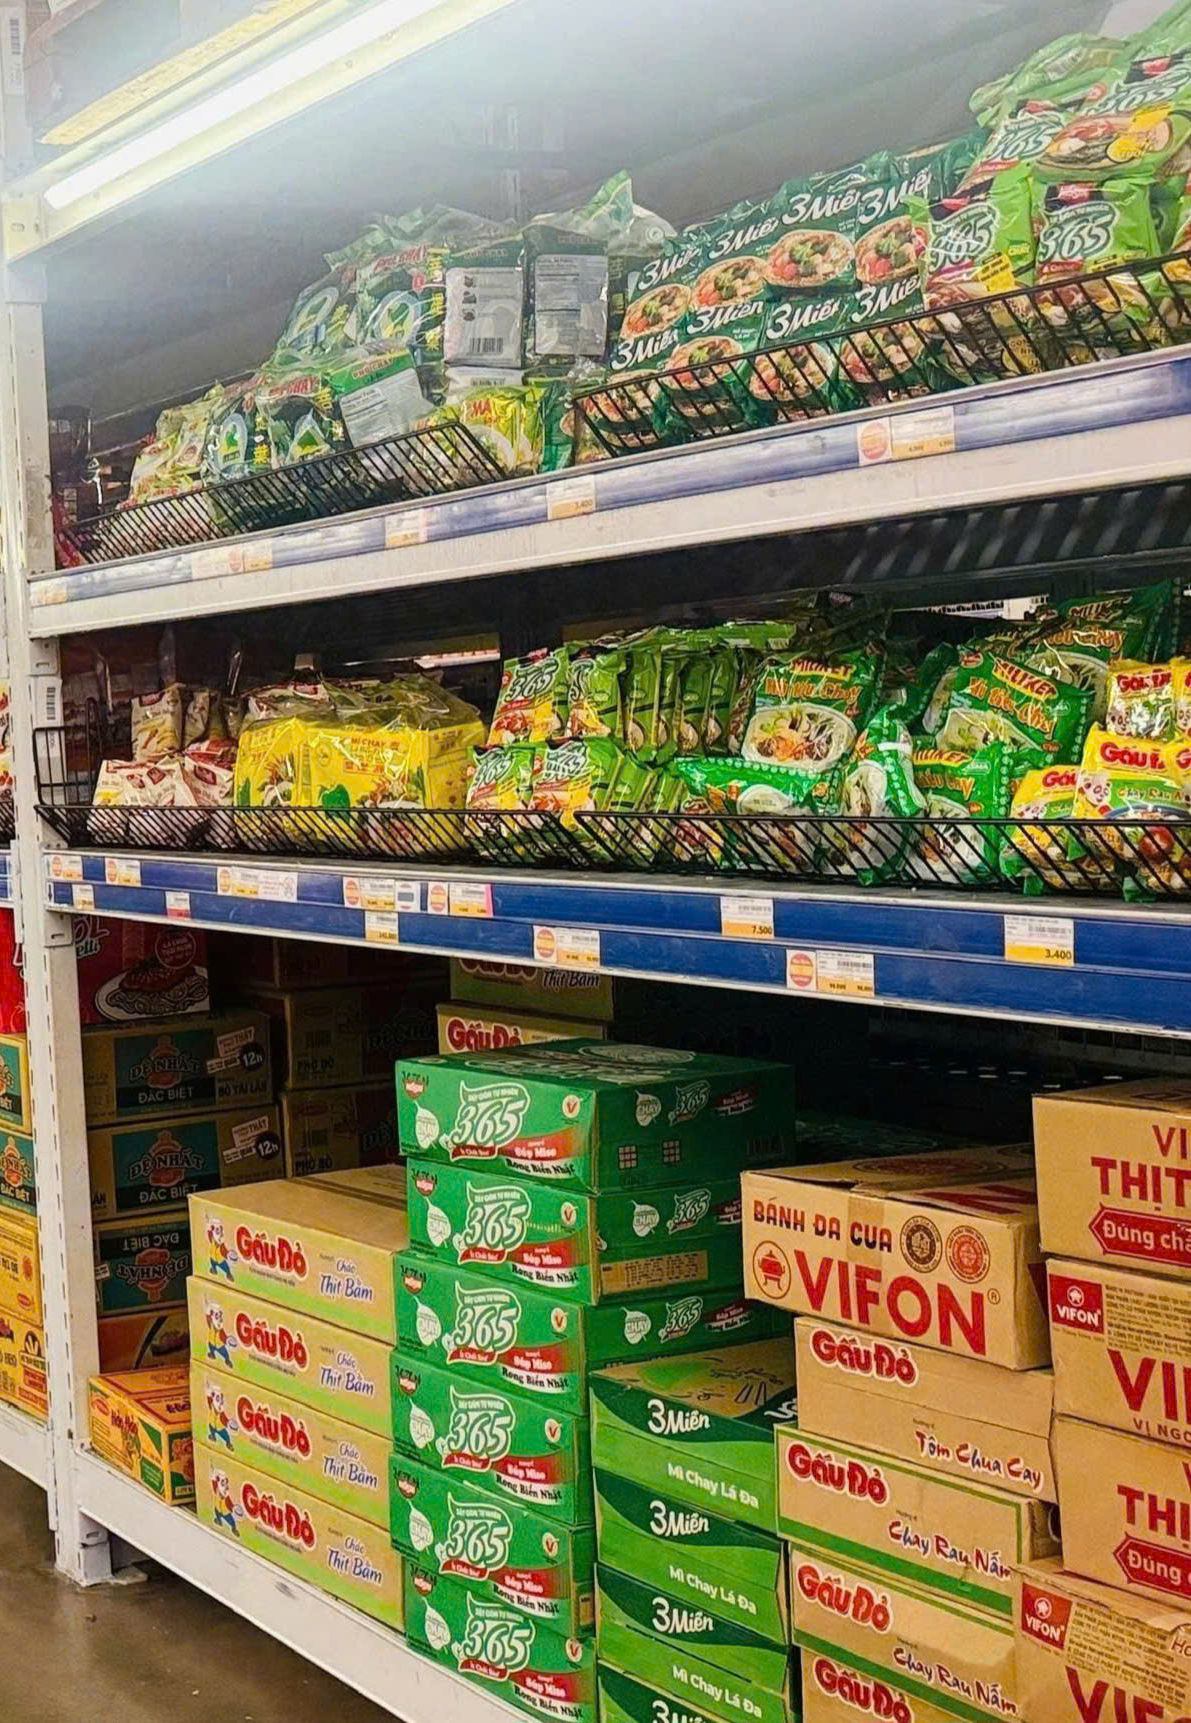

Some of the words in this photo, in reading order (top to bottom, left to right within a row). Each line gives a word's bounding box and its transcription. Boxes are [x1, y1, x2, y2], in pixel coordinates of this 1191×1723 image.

[1040, 215, 1108, 261] 365
[506, 662, 560, 700] 365
[1045, 949, 1072, 961] 3.400
[242, 1049, 263, 1067] 12h
[138, 1088, 165, 1106] ĐẶC
[167, 1086, 195, 1101] BIỆT
[451, 1100, 526, 1146] 365
[257, 1140, 278, 1156] 12h
[139, 1189, 167, 1204] ĐẶC
[463, 1202, 527, 1250] 365
[753, 1197, 805, 1232] BÁNH
[813, 1213, 841, 1241] ĐA
[850, 1221, 892, 1253] CUA
[1102, 1219, 1155, 1249] Đúng
[236, 1226, 276, 1268] Gấu
[277, 1236, 307, 1278] Đỏ
[320, 1274, 342, 1300] Thịt
[794, 1249, 987, 1356] VIFON
[453, 1307, 517, 1350] 365
[1056, 1304, 1099, 1327] VIFON
[236, 1312, 276, 1356] Gấu
[277, 1324, 307, 1369] Đỏ
[811, 1330, 872, 1372] Gấu
[872, 1340, 916, 1384] Đỏ
[320, 1367, 342, 1392] Thịt
[237, 1396, 279, 1443] Gấu
[279, 1414, 310, 1457] Đỏ
[446, 1405, 509, 1455] 365
[647, 1400, 710, 1435] 3Miền
[1133, 1418, 1151, 1437] VỊ
[1157, 1423, 1191, 1443] NGO
[322, 1456, 345, 1483] Thịt
[787, 1444, 845, 1493] Gấu
[847, 1466, 888, 1504] Đỏ
[914, 1429, 950, 1460] Tôm
[955, 1443, 1003, 1473] Chua
[1006, 1457, 1043, 1492] Cay
[668, 1463, 684, 1480] Mì
[686, 1469, 718, 1495] Chay
[721, 1482, 737, 1499] Lá
[739, 1490, 759, 1508] Đa
[241, 1483, 283, 1528] Gấu
[284, 1503, 315, 1548] Đỏ
[649, 1501, 709, 1538] 3Miền
[1117, 1484, 1191, 1549] THỊ
[327, 1548, 349, 1573] Thịt
[445, 1521, 509, 1572] 365
[888, 1520, 930, 1561] Chay
[934, 1534, 971, 1565] Rau
[669, 1564, 685, 1583] Mì
[687, 1571, 718, 1601] Chay
[720, 1587, 736, 1605] Lá
[738, 1594, 757, 1615] Đa
[1127, 1549, 1181, 1585] Đúng
[652, 1597, 714, 1635] 3Miền
[797, 1565, 849, 1616] Gấu
[850, 1585, 891, 1632] Đỏ
[463, 1618, 530, 1665] 365
[1025, 1614, 1060, 1641] VIFON
[673, 1664, 688, 1683] Mì
[689, 1672, 723, 1701] Chay
[724, 1686, 740, 1705] Lá
[742, 1694, 763, 1718] Đa
[814, 1658, 871, 1707] Gấu
[871, 1679, 912, 1723] Đỏ
[893, 1647, 934, 1681] Chay
[936, 1666, 971, 1697] Rau
[975, 1684, 1018, 1716] Nấm
